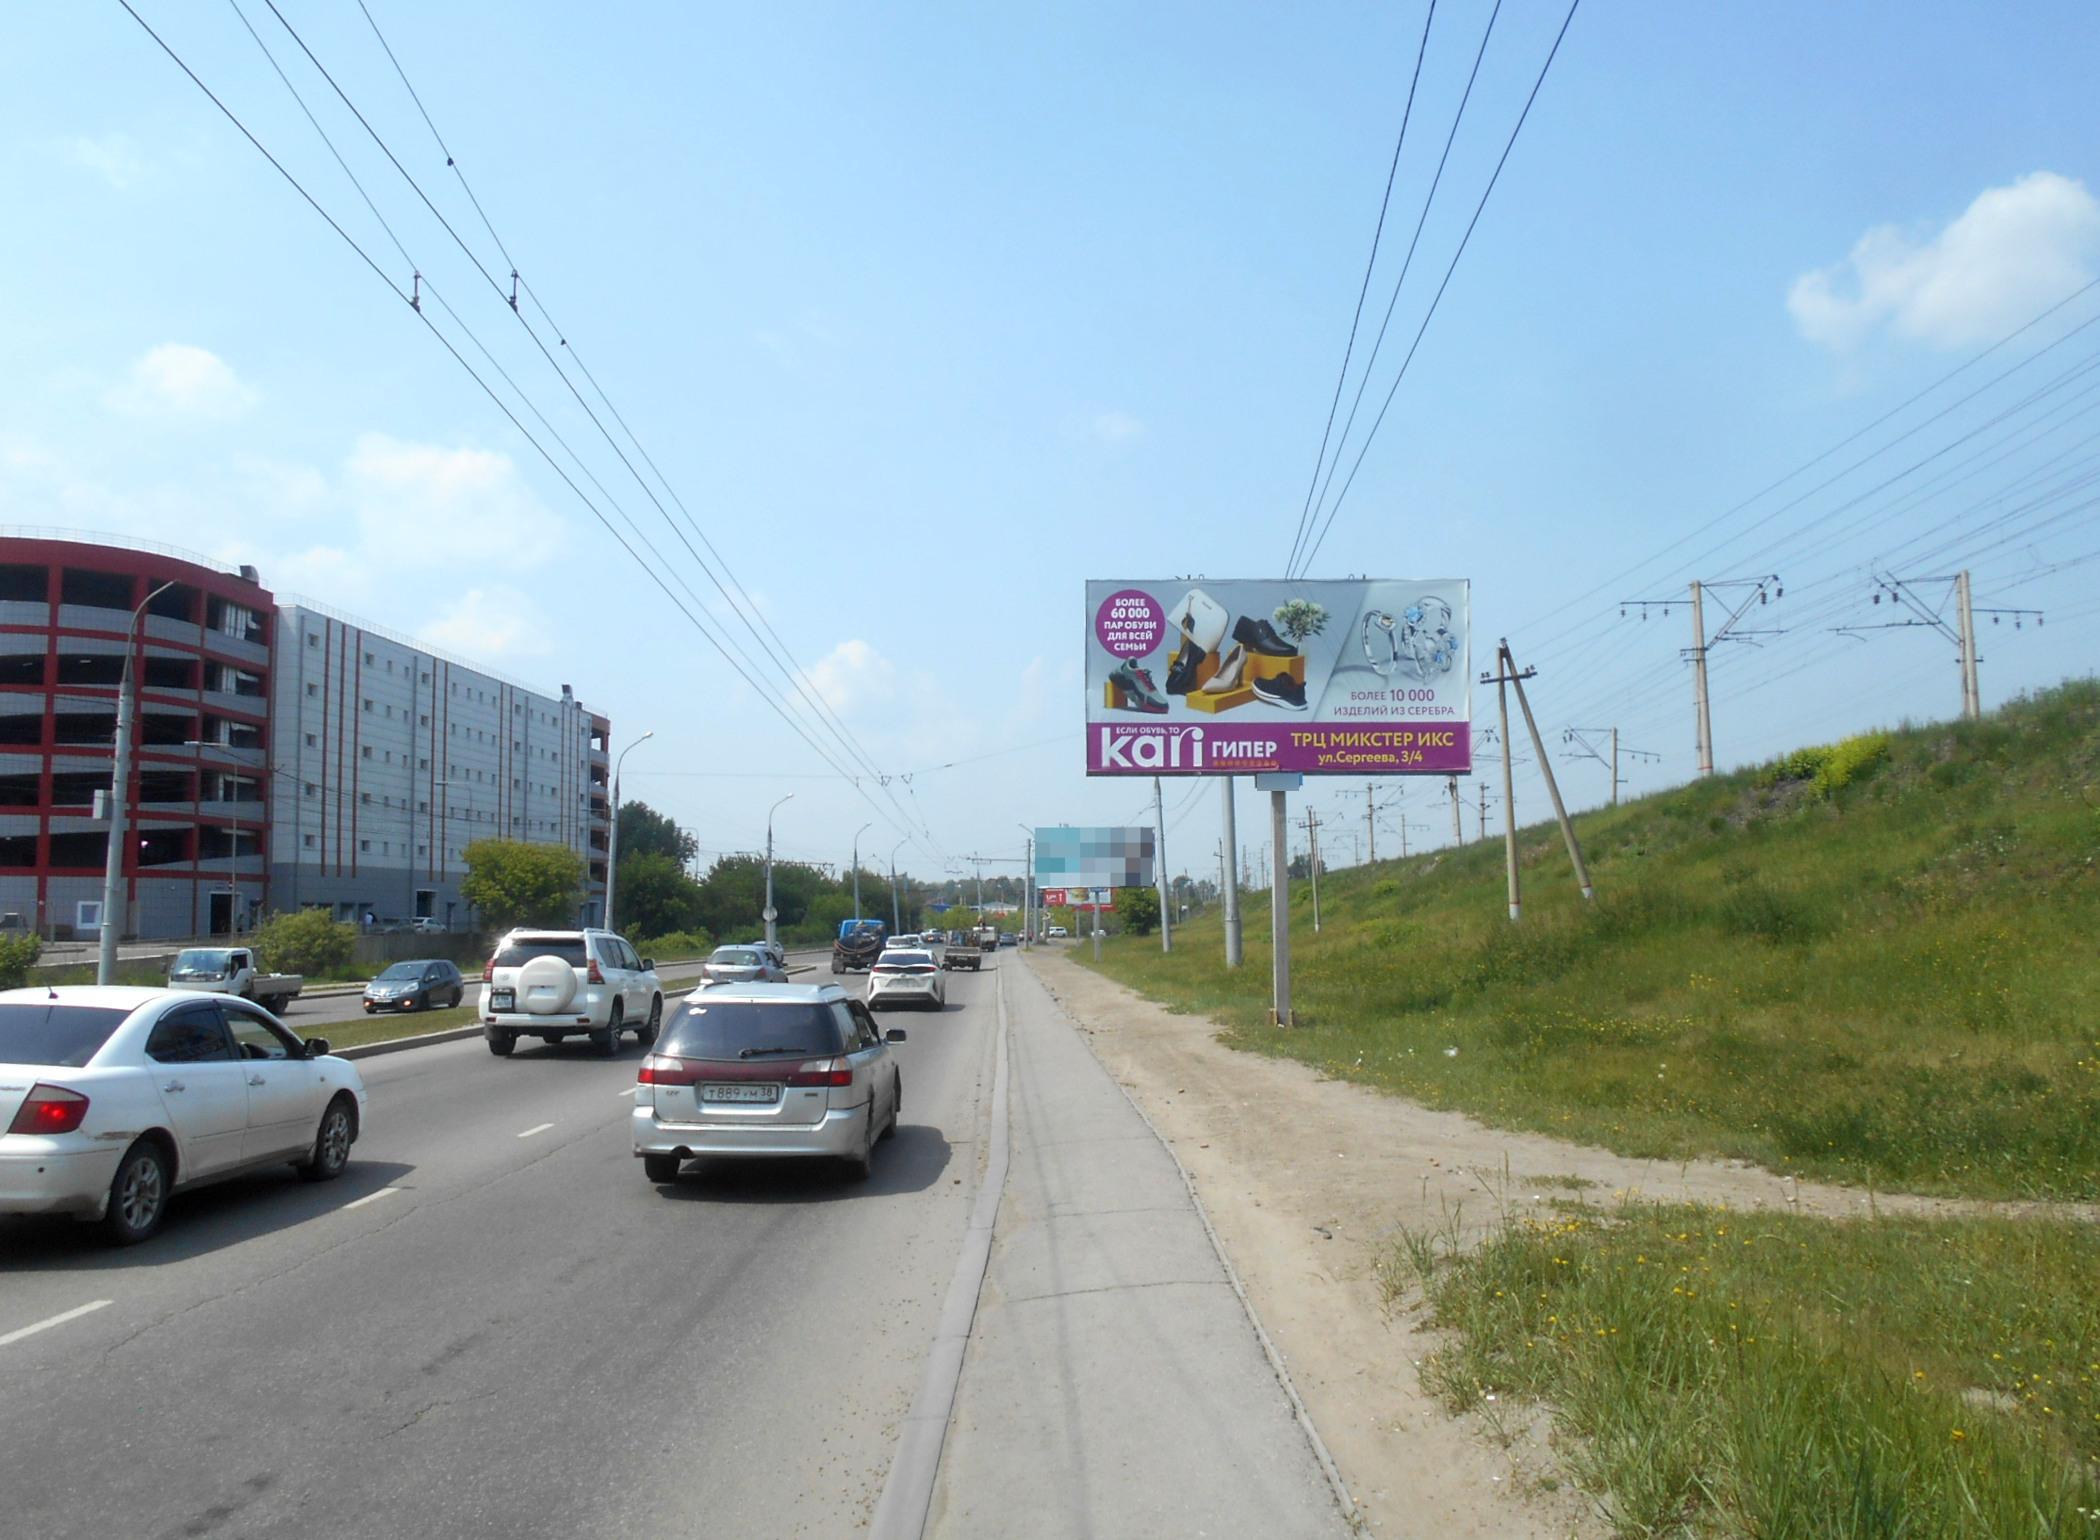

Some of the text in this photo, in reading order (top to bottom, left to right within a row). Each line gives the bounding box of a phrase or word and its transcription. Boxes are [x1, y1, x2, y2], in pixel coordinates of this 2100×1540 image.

[1115, 598, 1145, 606] БОЛЕЕ
[1111, 607, 1150, 618] 60 000
[1104, 621, 1157, 629] ПАР ОБУВИ
[1107, 630, 1153, 641] ДЛЯ ВСЕЙ
[1114, 643, 1146, 651] СЕМЬИ
[1351, 689, 1435, 702] БОЛЕЕ 10 000
[1334, 705, 1454, 716] ИЗДЕЛИЙ ИЗ СЕРЕБРА
[1139, 727, 1167, 735] ОБУВЬ,
[1291, 732, 1454, 748] ТРЦ МИКСТЕР ИКС
[1101, 726, 1204, 768] kari
[1212, 741, 1277, 758] ГИПЕР
[1401, 751, 1423, 763] 3/4
